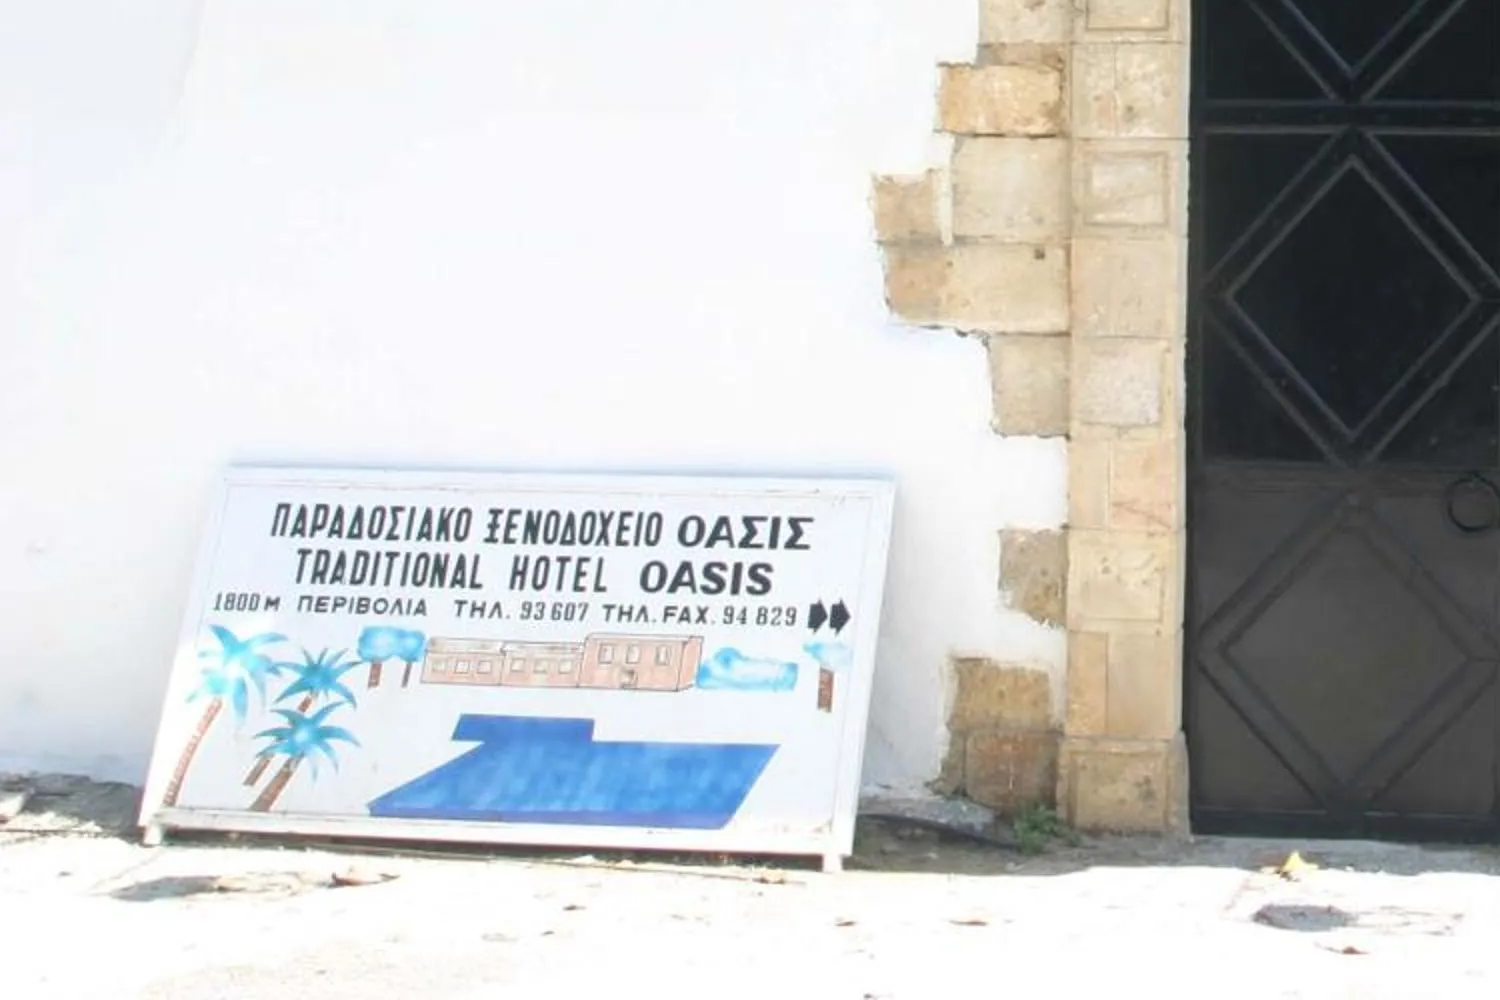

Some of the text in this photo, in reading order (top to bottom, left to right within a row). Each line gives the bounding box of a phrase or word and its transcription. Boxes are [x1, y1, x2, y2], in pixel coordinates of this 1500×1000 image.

[270, 502, 815, 551] ΠΑΡΑΔΟΣΙΑΚΟ ΞΕΝΟΔΟΧΕΙΟ ΟΑΣΙΣ
[295, 547, 774, 597] TRADITIONAL HOTEL OASIS
[296, 594, 427, 617] ΠΕΡΙΒΟΛΙΑ
